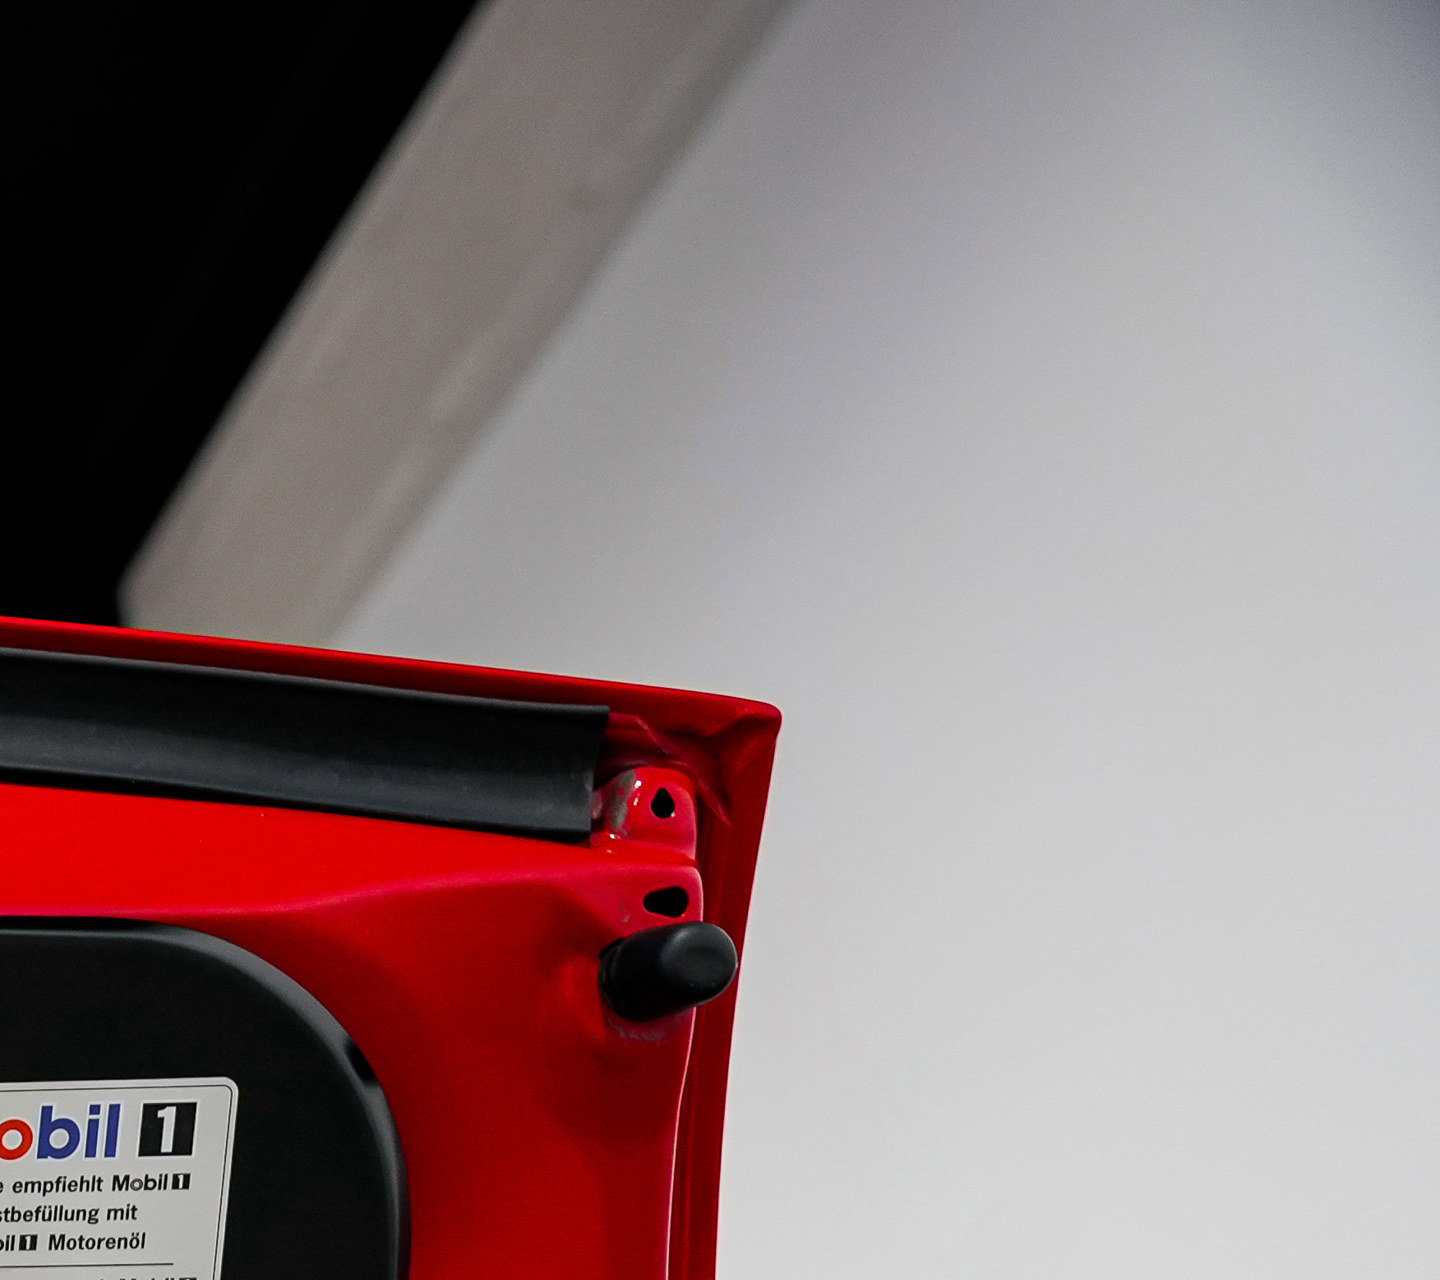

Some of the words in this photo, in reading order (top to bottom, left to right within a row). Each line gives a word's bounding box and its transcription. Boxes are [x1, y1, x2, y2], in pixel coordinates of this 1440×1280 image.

[12, 1175, 104, 1197] empfiehlt
[106, 1203, 138, 1221] mit
[48, 1232, 146, 1251] Motorenöl
